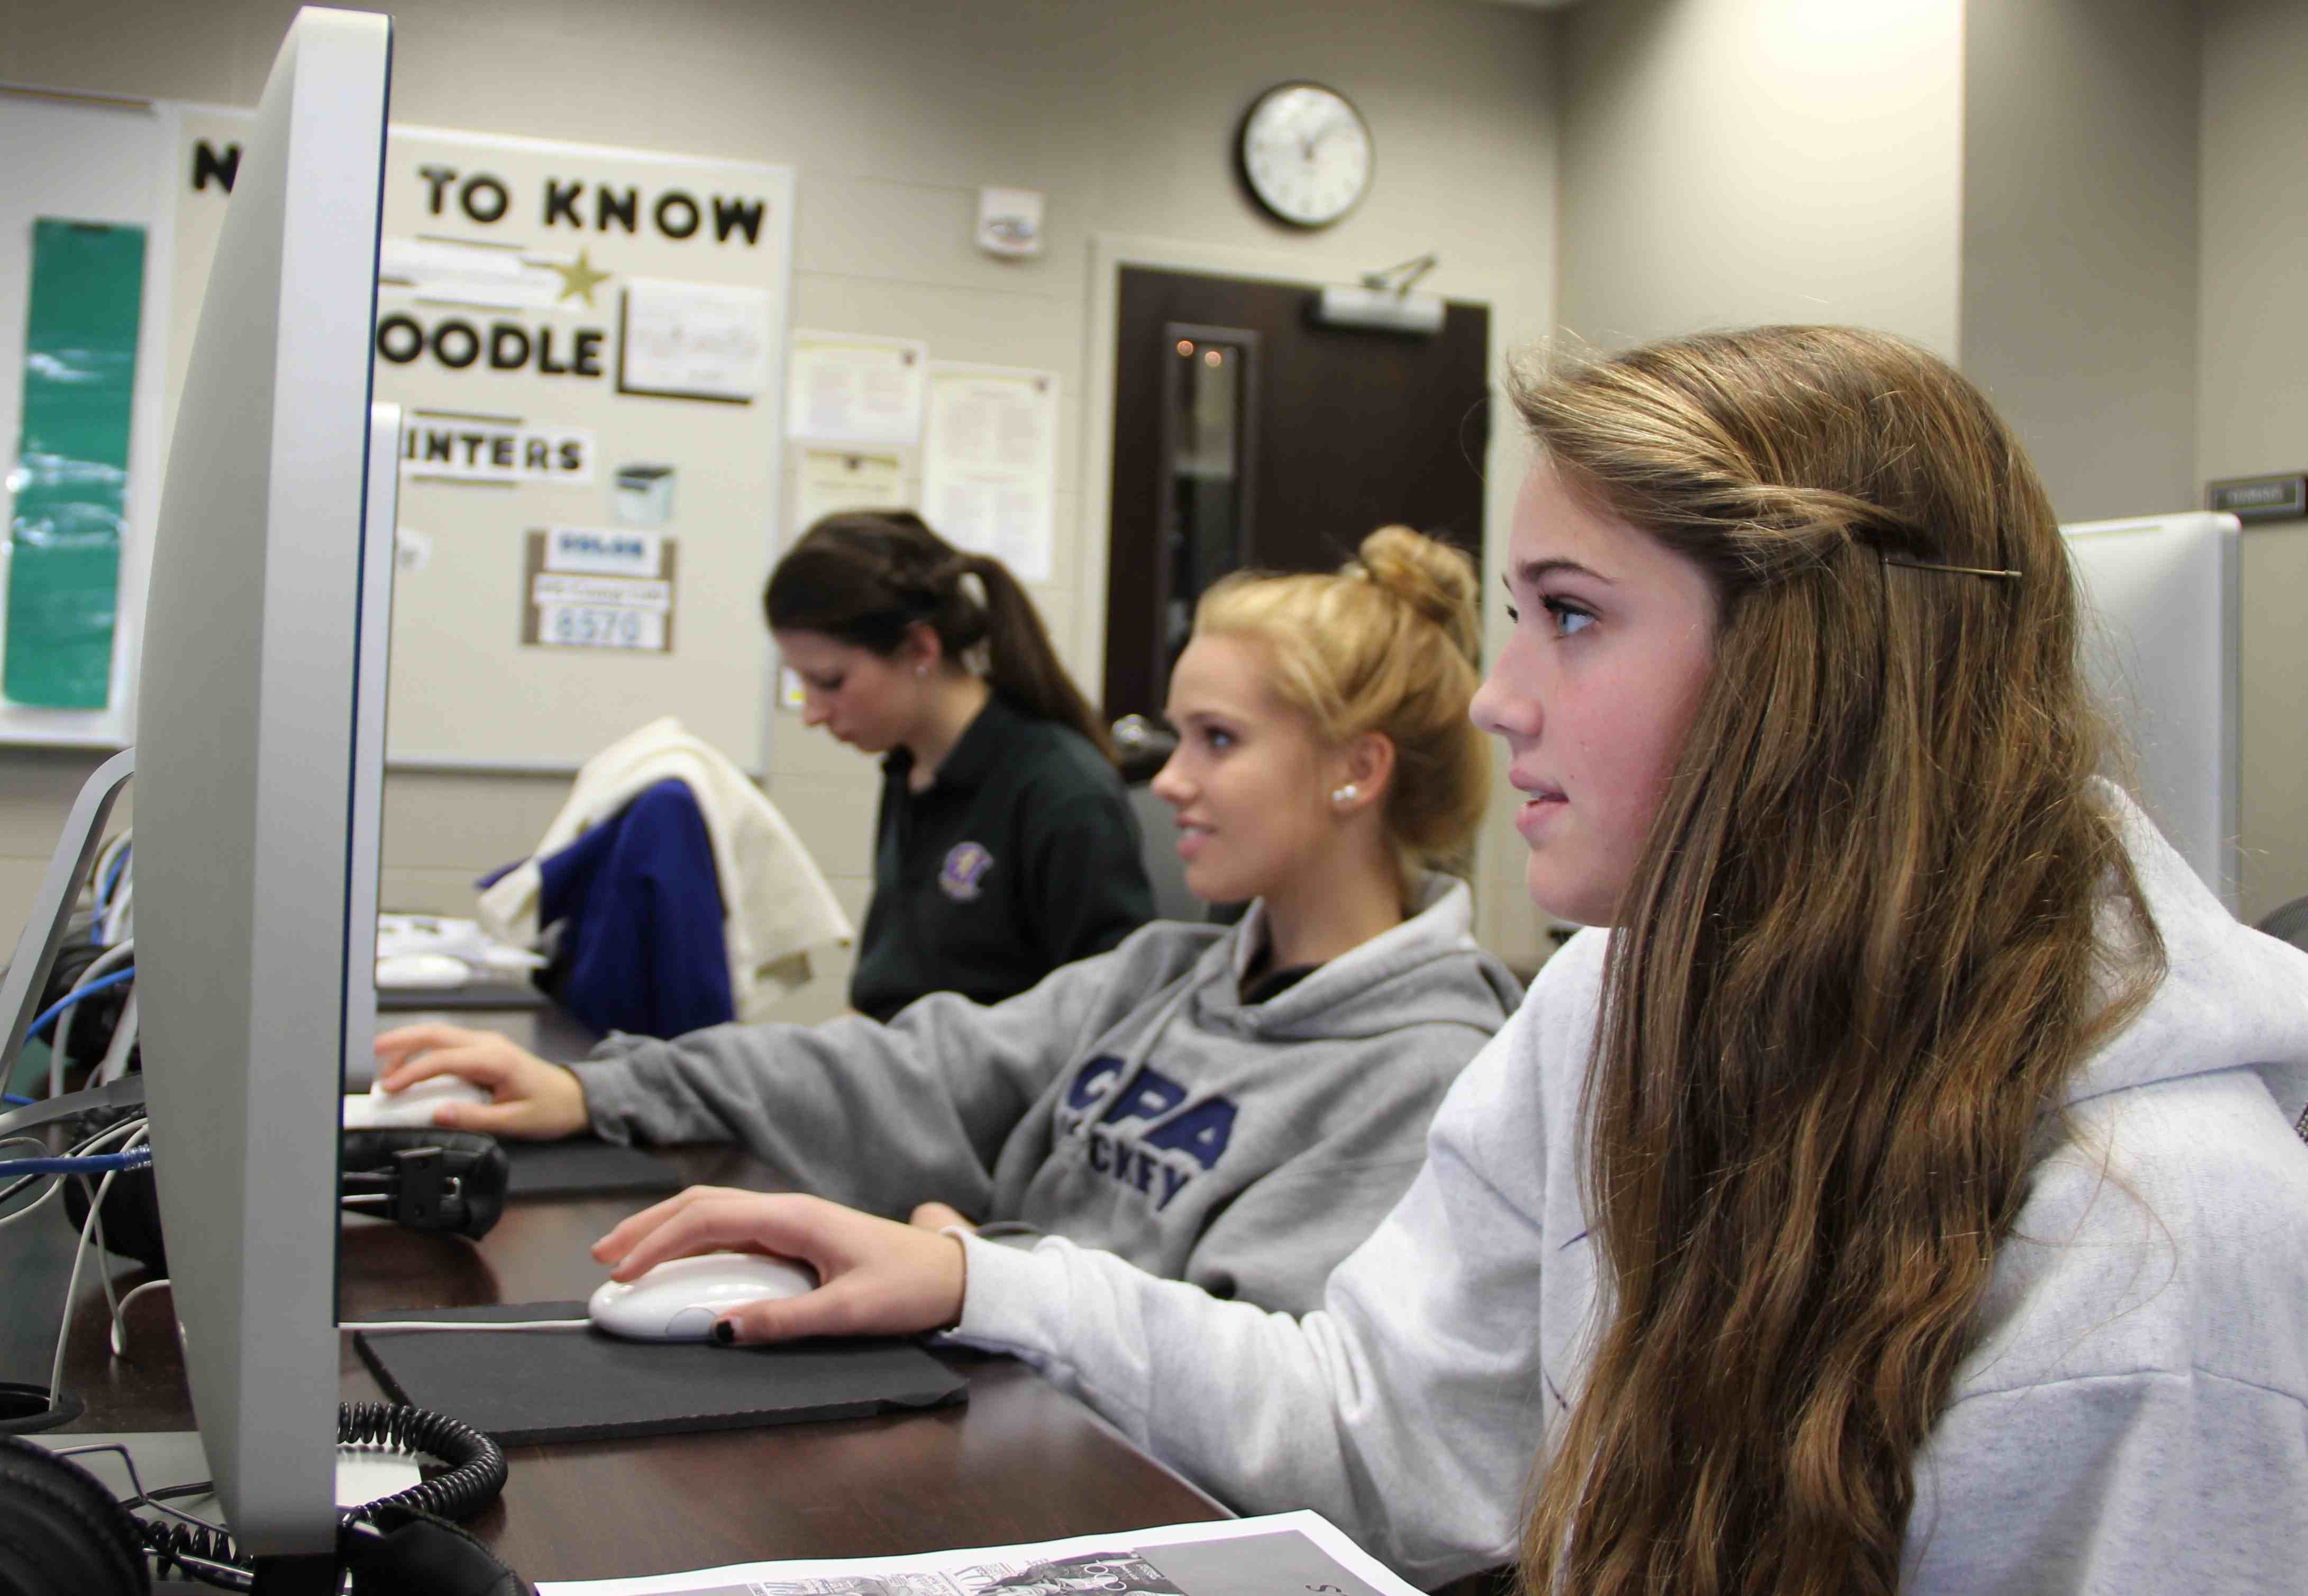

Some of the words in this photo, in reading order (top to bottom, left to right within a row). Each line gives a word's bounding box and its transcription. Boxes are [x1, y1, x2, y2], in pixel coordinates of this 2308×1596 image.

[419, 167, 510, 224] TO
[543, 179, 766, 247] KNOW
[377, 313, 605, 378] OODLE
[406, 427, 581, 472] INTERS
[1069, 1054, 1239, 1171] CPA
